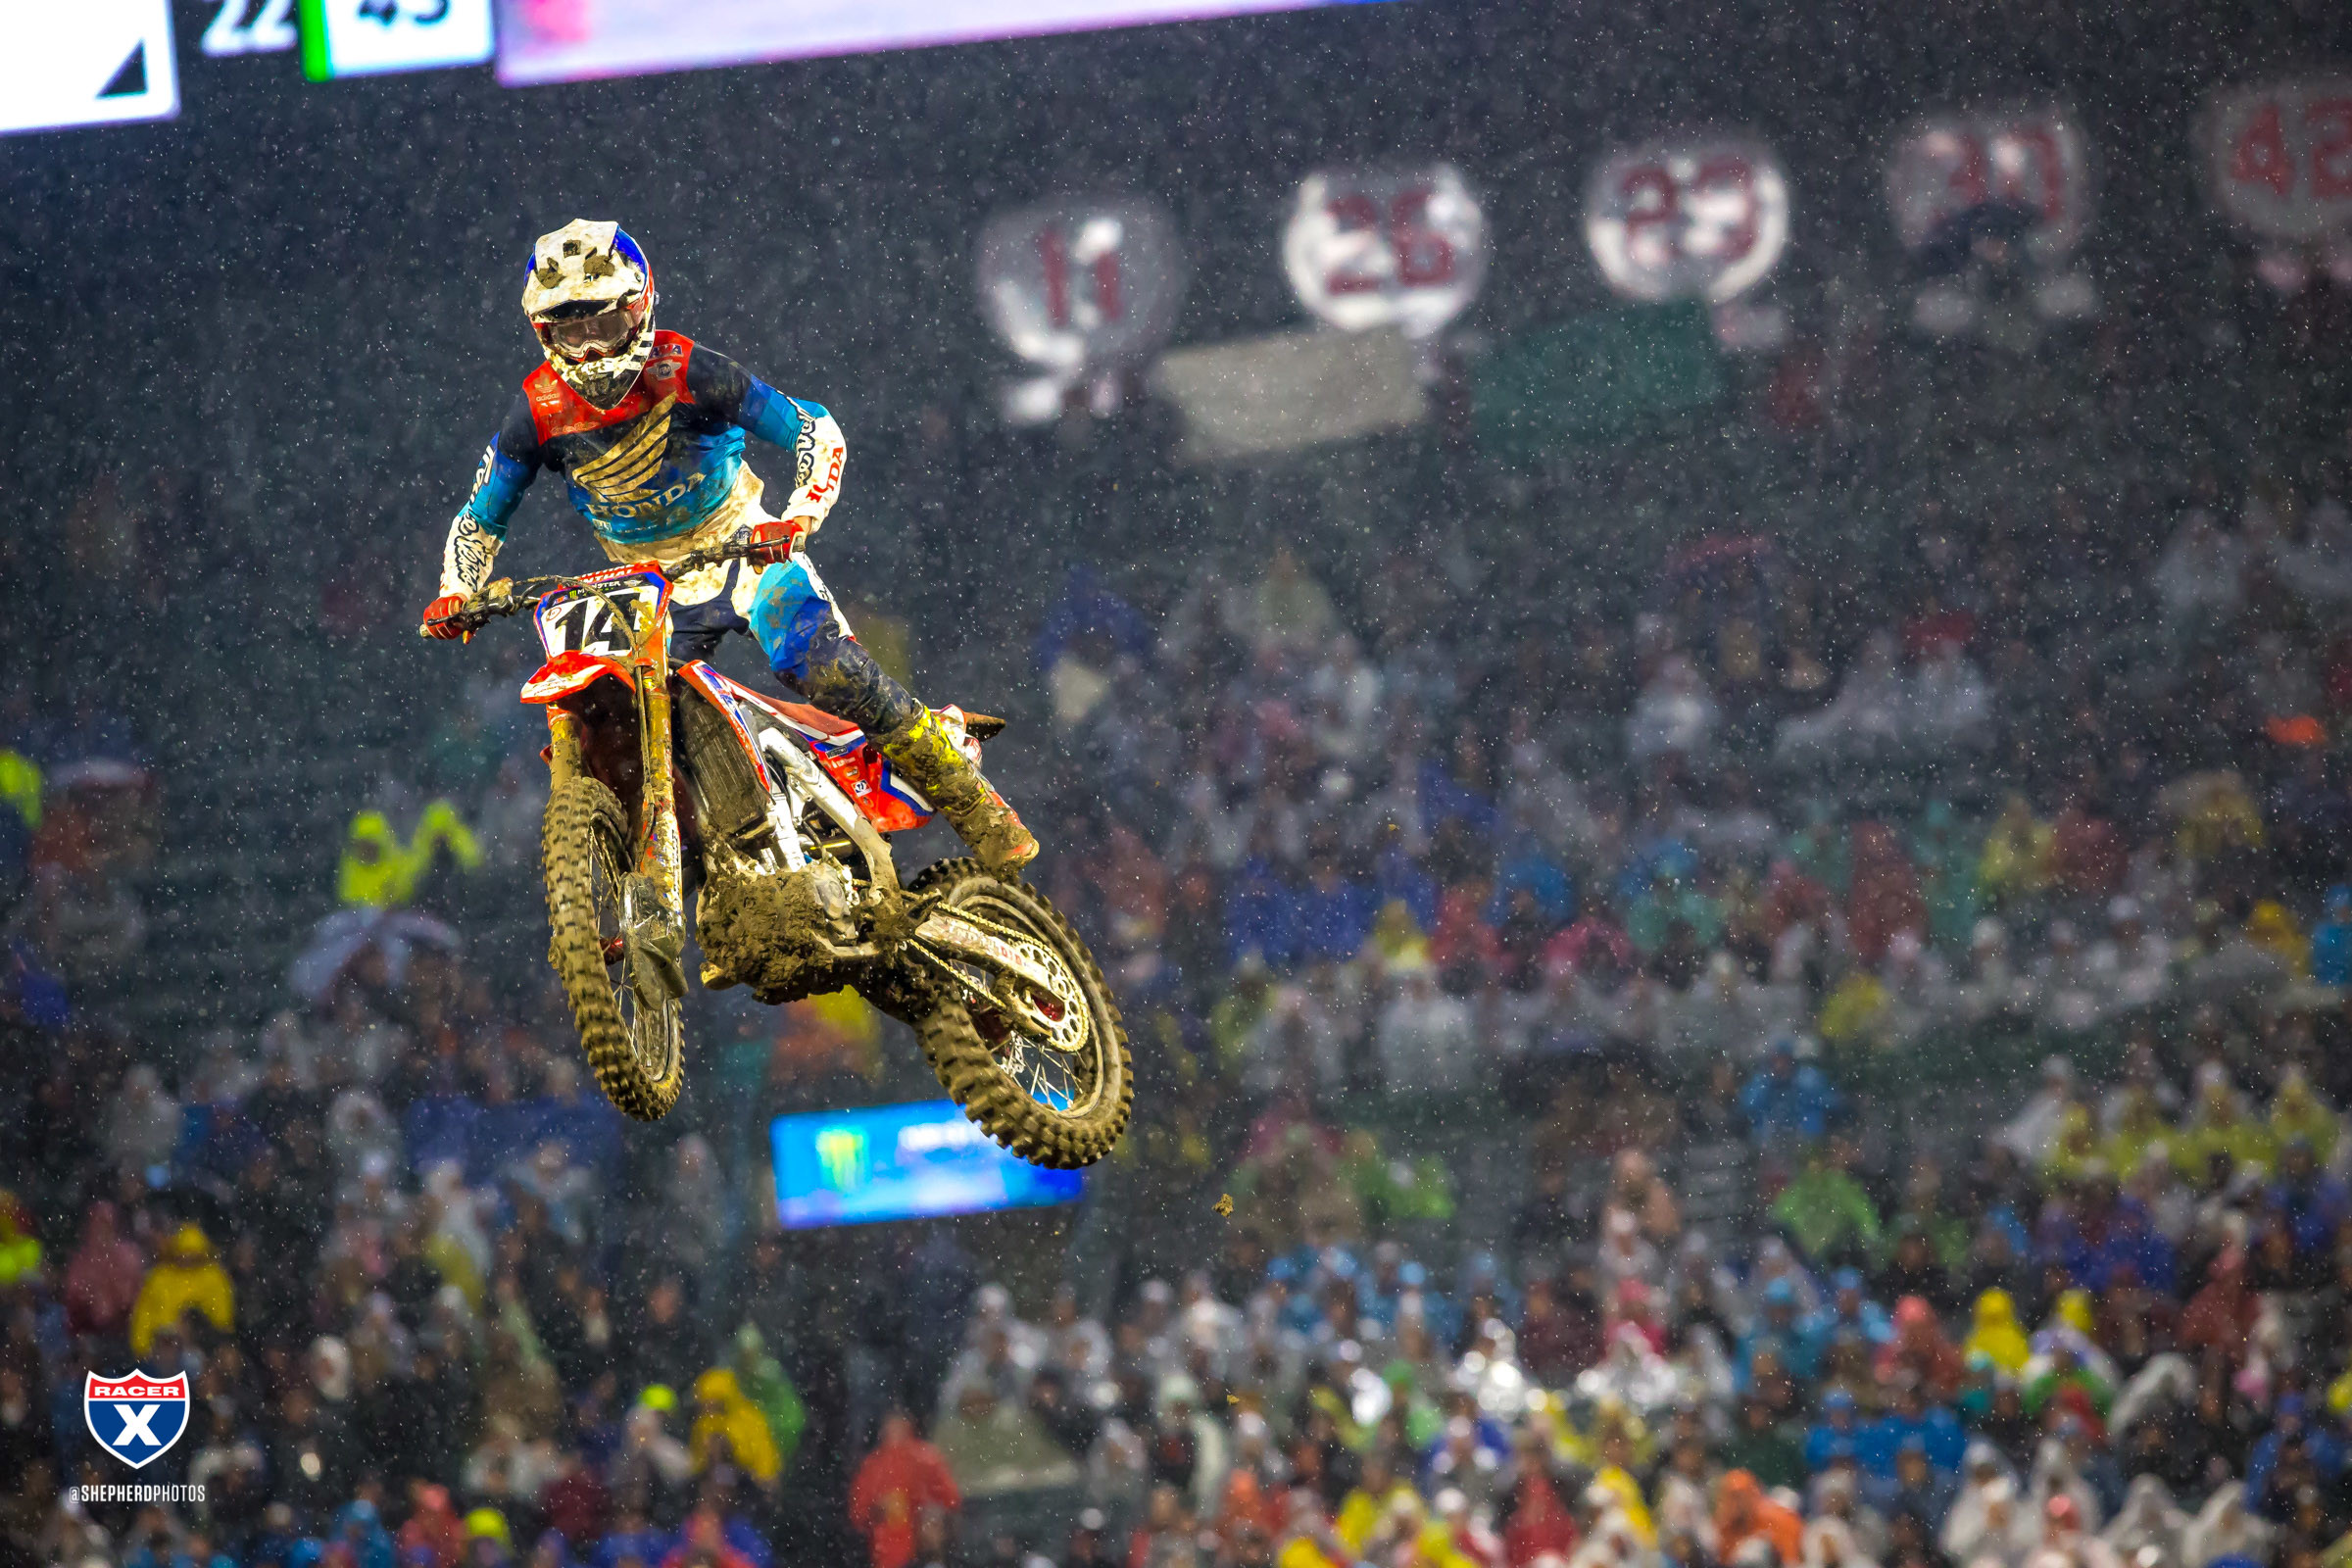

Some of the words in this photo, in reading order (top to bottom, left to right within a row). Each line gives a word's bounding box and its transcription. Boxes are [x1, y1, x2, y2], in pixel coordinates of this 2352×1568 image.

[1323, 186, 1457, 295] 26
[585, 471, 707, 518] HONDA
[577, 580, 621, 595] MNSTER
[555, 592, 641, 652] 14
